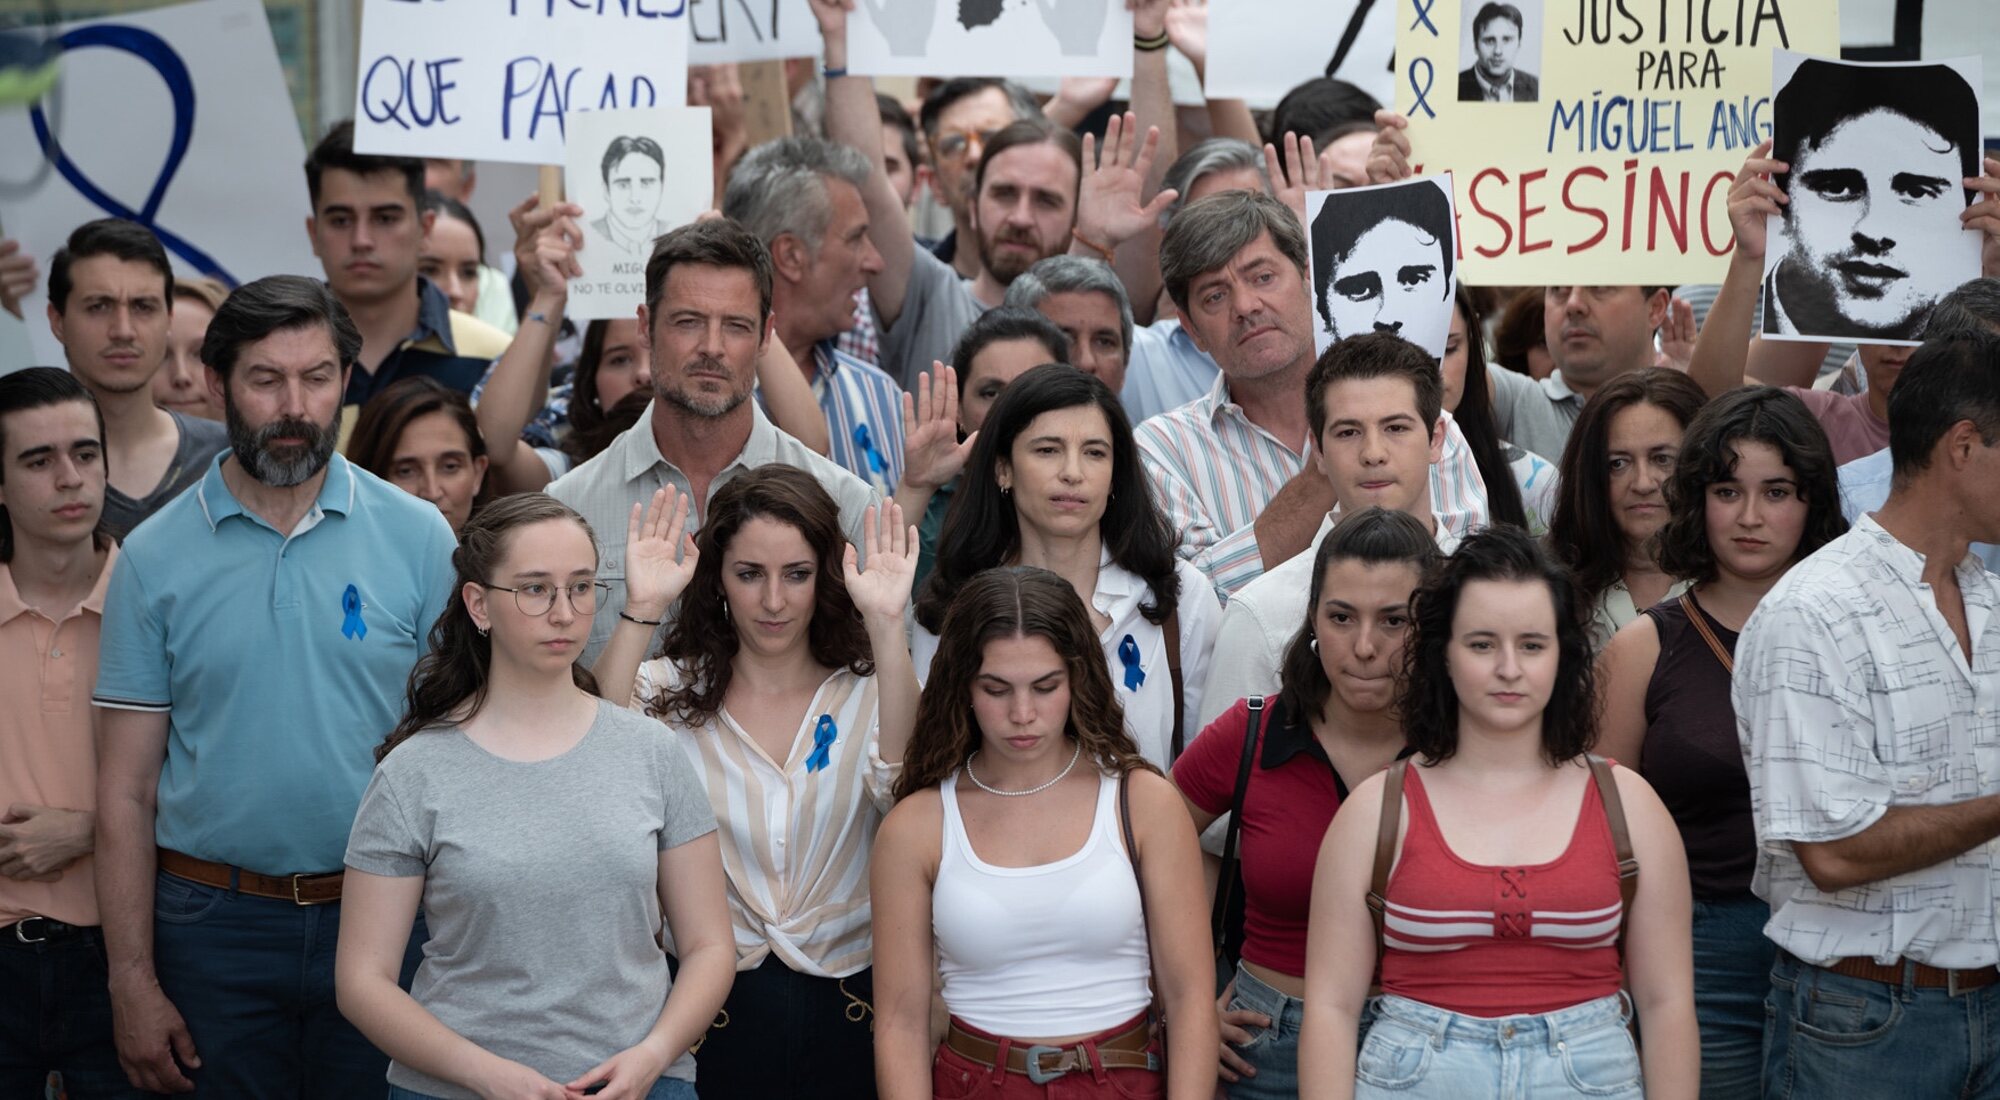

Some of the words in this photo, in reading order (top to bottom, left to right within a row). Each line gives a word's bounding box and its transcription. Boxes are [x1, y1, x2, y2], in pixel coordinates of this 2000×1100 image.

[1563, 0, 1789, 50] JUSTICIA
[362, 55, 463, 130] QUE
[1636, 49, 1726, 91] PARA
[573, 283, 593, 295] NO
[597, 283, 612, 294] TE
